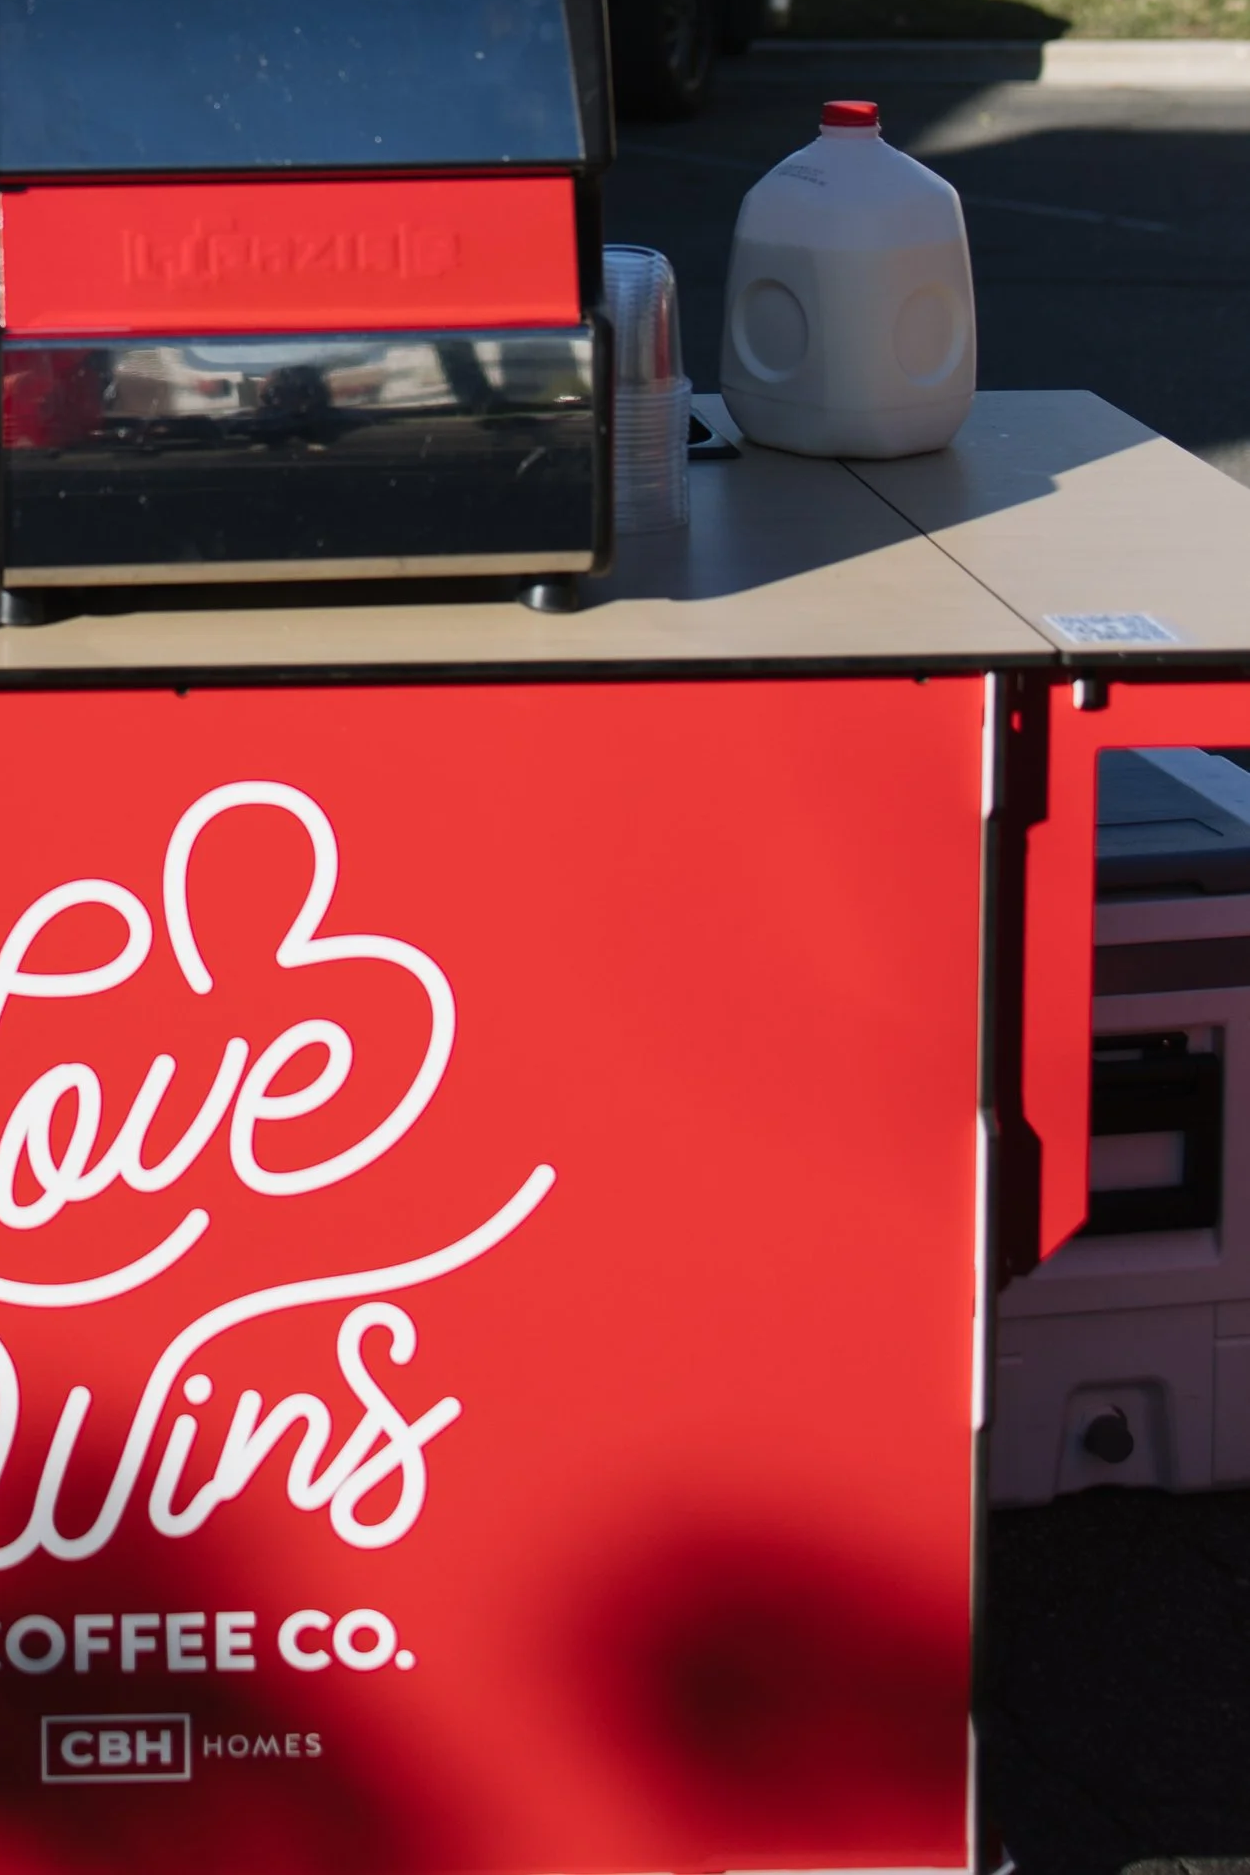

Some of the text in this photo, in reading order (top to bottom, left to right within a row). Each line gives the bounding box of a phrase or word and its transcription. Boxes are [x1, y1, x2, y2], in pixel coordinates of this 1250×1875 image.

[278, 1609, 416, 1671] CO.
[61, 1730, 323, 1767] CBH HOMES
